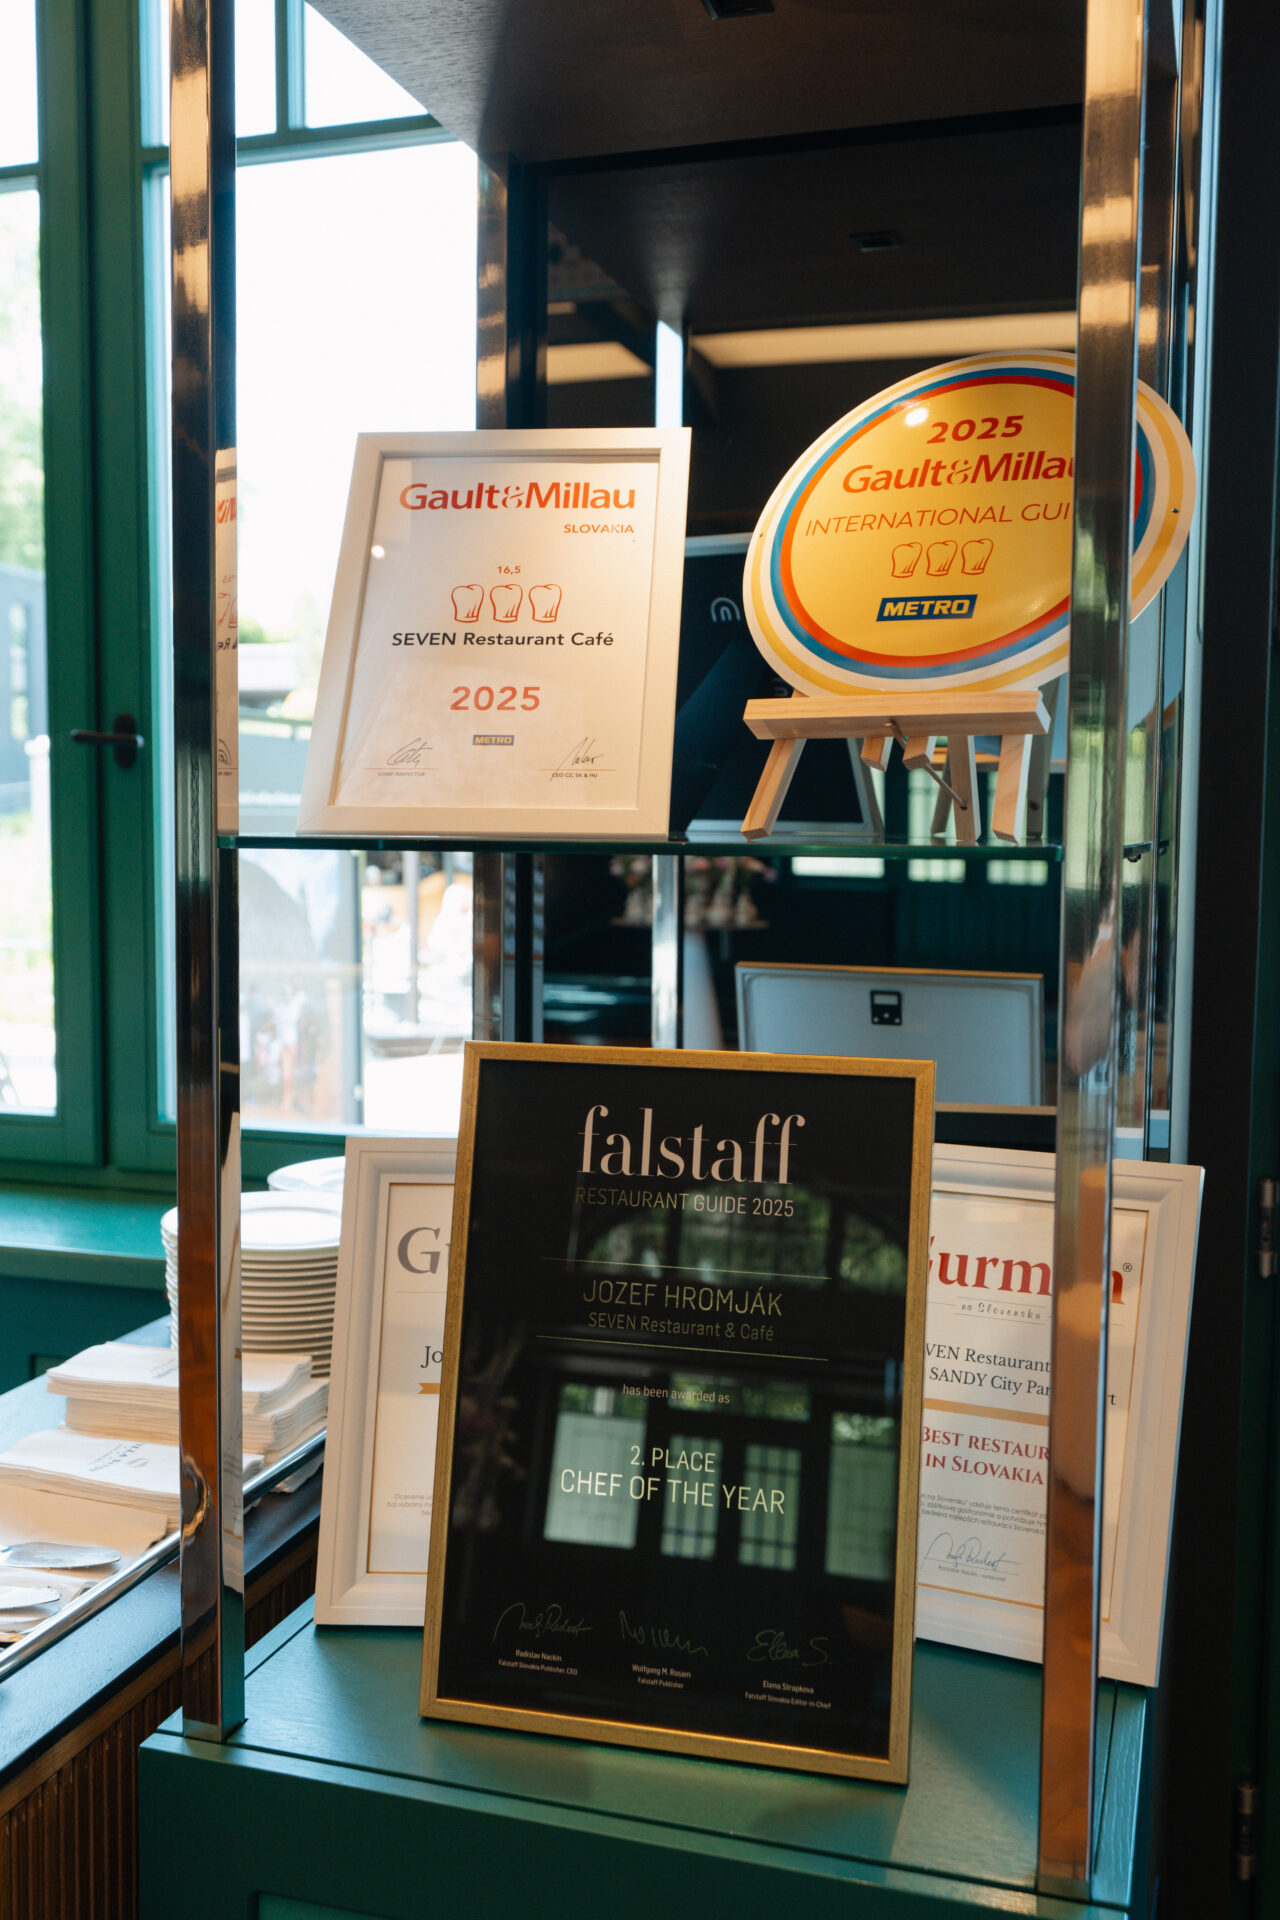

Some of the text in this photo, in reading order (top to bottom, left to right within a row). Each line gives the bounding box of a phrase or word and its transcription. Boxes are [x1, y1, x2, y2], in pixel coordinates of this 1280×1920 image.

[926, 415, 1024, 444] 2025
[400, 482, 636, 510] Gault&Millau
[563, 523, 634, 534] SLOVAKIA
[805, 502, 1070, 537] INTERNATIONAL GUI
[497, 566, 521, 575] 16,5
[882, 599, 970, 618] METRO
[391, 631, 614, 646] SEVEN Restaurant Café
[450, 686, 541, 711] 2025
[474, 736, 513, 745] METRO
[576, 1104, 806, 1185] falstaff
[575, 1186, 794, 1217] RESTAURANT GUIDE 2025
[398, 1227, 449, 1274] G
[583, 1279, 783, 1317] JOZEF HROMJÁK
[588, 1312, 774, 1341] SEVEN Restaurant & Café
[421, 1346, 443, 1369] Jo
[925, 1342, 1050, 1373] VEN Restaurant
[622, 1383, 731, 1404] has been awarded as
[929, 1366, 1050, 1396] SANDY City Par
[630, 1445, 716, 1473] 2. PLACE
[968, 1435, 1049, 1461] RESTAUR
[925, 1453, 1044, 1485] IN SLOVAKIA
[560, 1468, 785, 1515] CHEF OF THE YEAR
